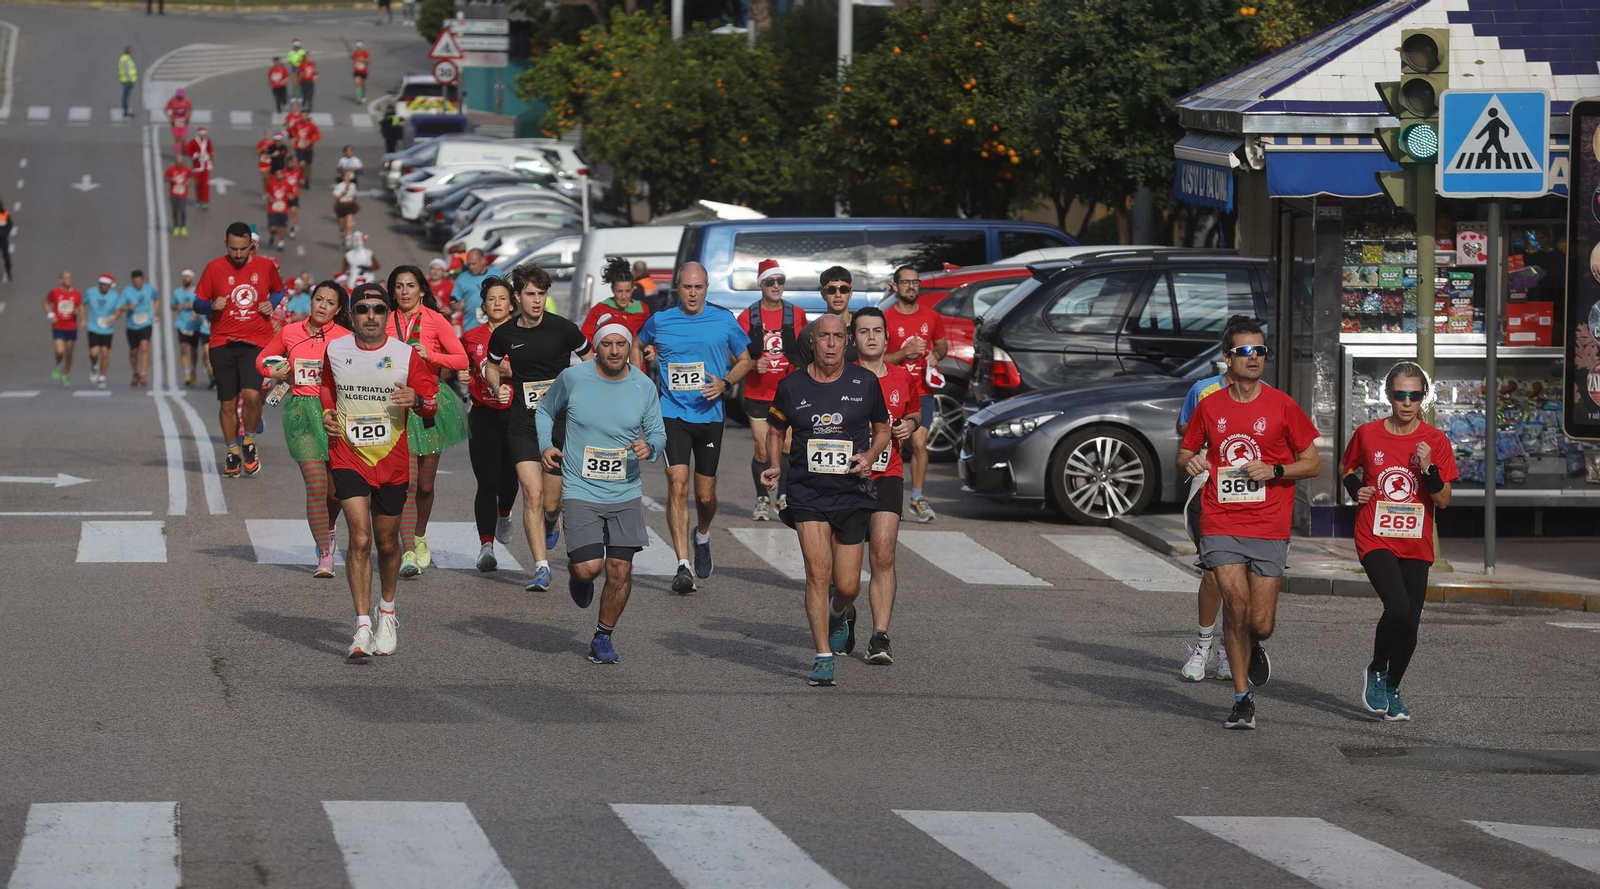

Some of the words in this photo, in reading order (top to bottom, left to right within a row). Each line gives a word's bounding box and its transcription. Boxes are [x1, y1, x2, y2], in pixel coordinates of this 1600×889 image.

[672, 373, 700, 384] 212
[351, 425, 386, 438] 120
[587, 458, 622, 472] 382
[811, 452, 847, 465] 413
[1222, 479, 1259, 493] 360
[1380, 514, 1417, 529] 269
